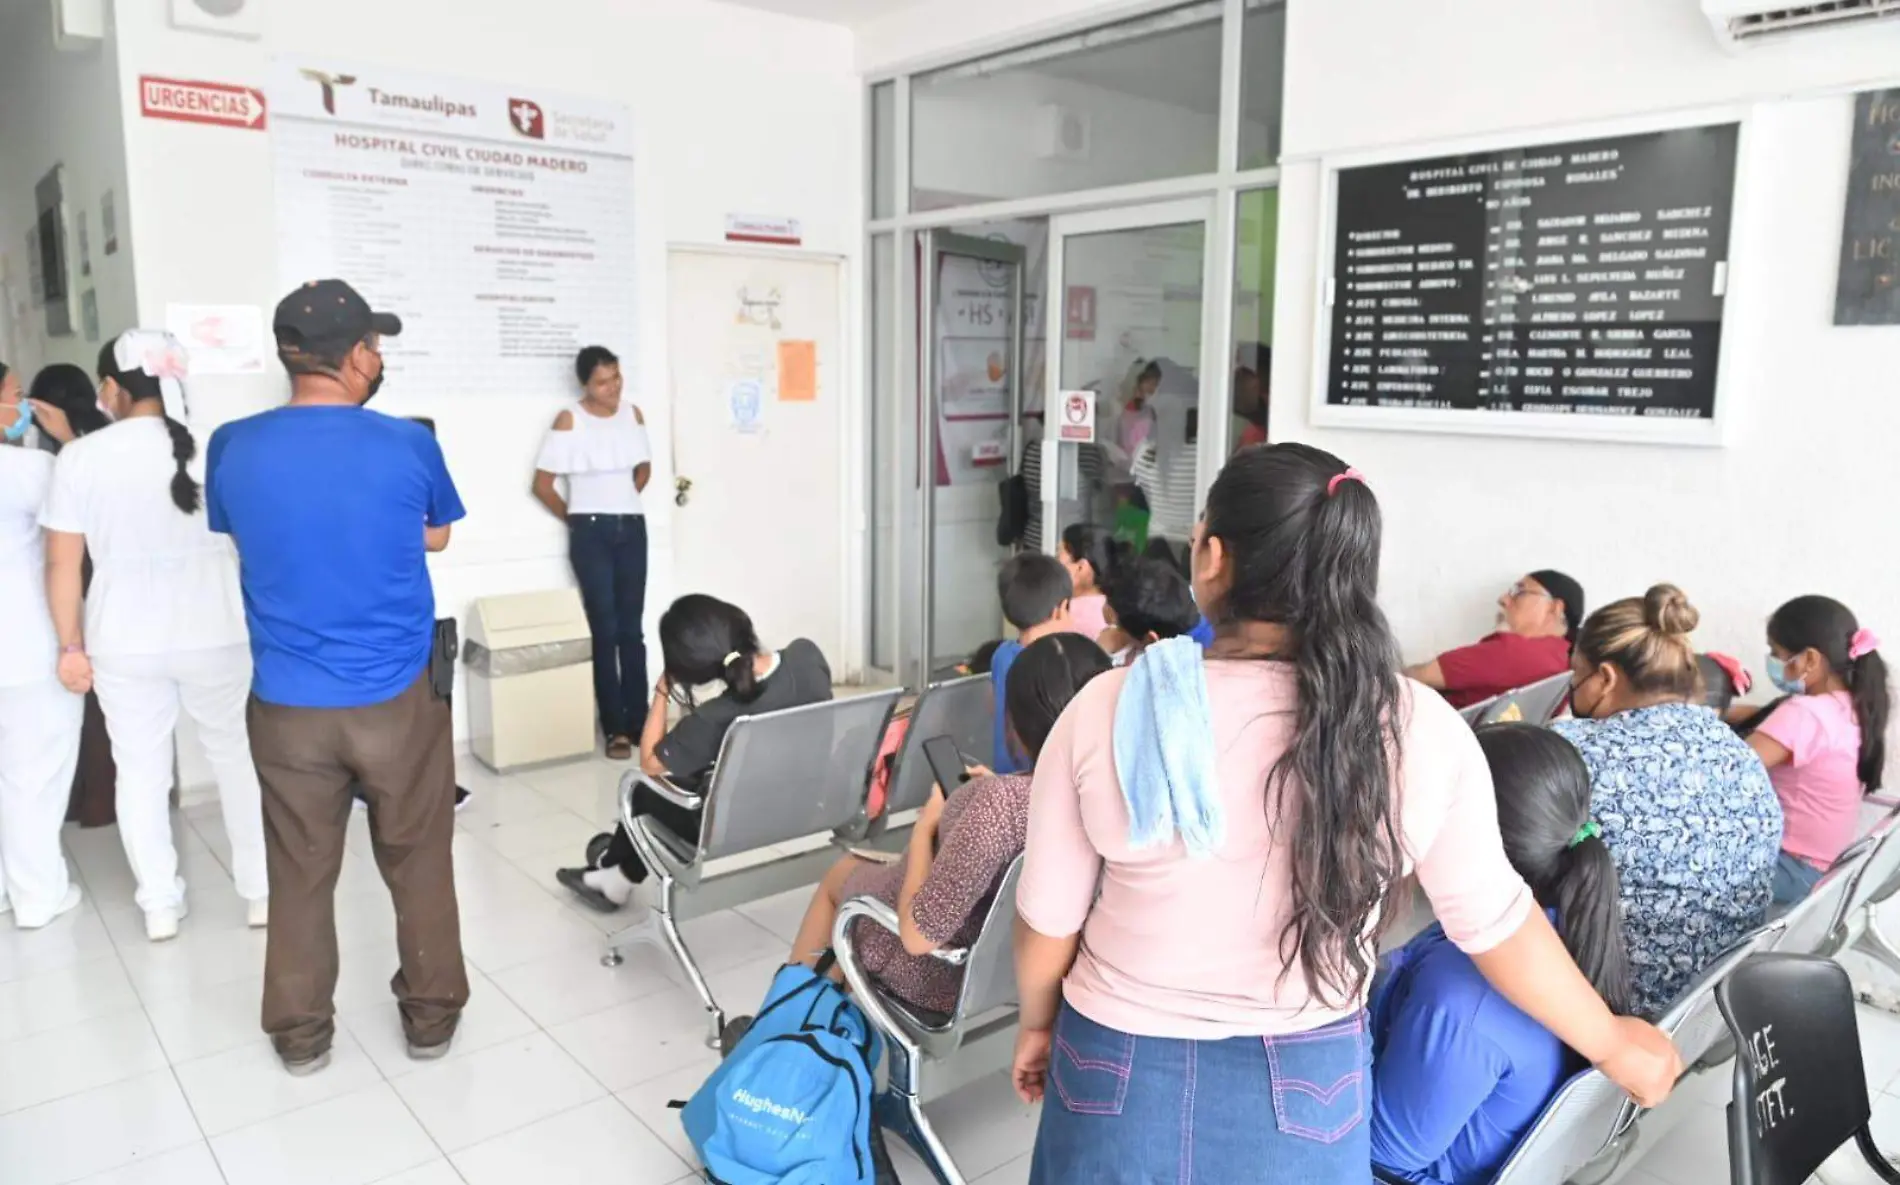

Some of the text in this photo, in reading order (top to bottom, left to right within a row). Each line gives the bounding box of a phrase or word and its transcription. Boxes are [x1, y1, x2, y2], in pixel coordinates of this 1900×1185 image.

[147, 86, 250, 118] URGENCIAS
[368, 87, 477, 118] Tamaulipas
[334, 133, 588, 173] HOSPITAL CIVIL CIUDAD MADERO
[1410, 166, 1465, 182] HOSPITAL
[1469, 162, 1499, 176] CIVIL
[1570, 149, 1619, 165] MADERO
[1656, 206, 1712, 221] SANCHEZ
[1599, 229, 1653, 243] SANCHEZ
[1599, 249, 1648, 262] DELGADO
[1577, 270, 1637, 283] SEPULVEDA
[1583, 310, 1618, 322] LOPEZ
[1628, 308, 1665, 322] LOPEZ
[1653, 328, 1693, 340] GARCIA
[1663, 348, 1694, 360] LEAL
[1575, 367, 1630, 379] GONZALEZ
[1632, 367, 1693, 380] GUERRERO
